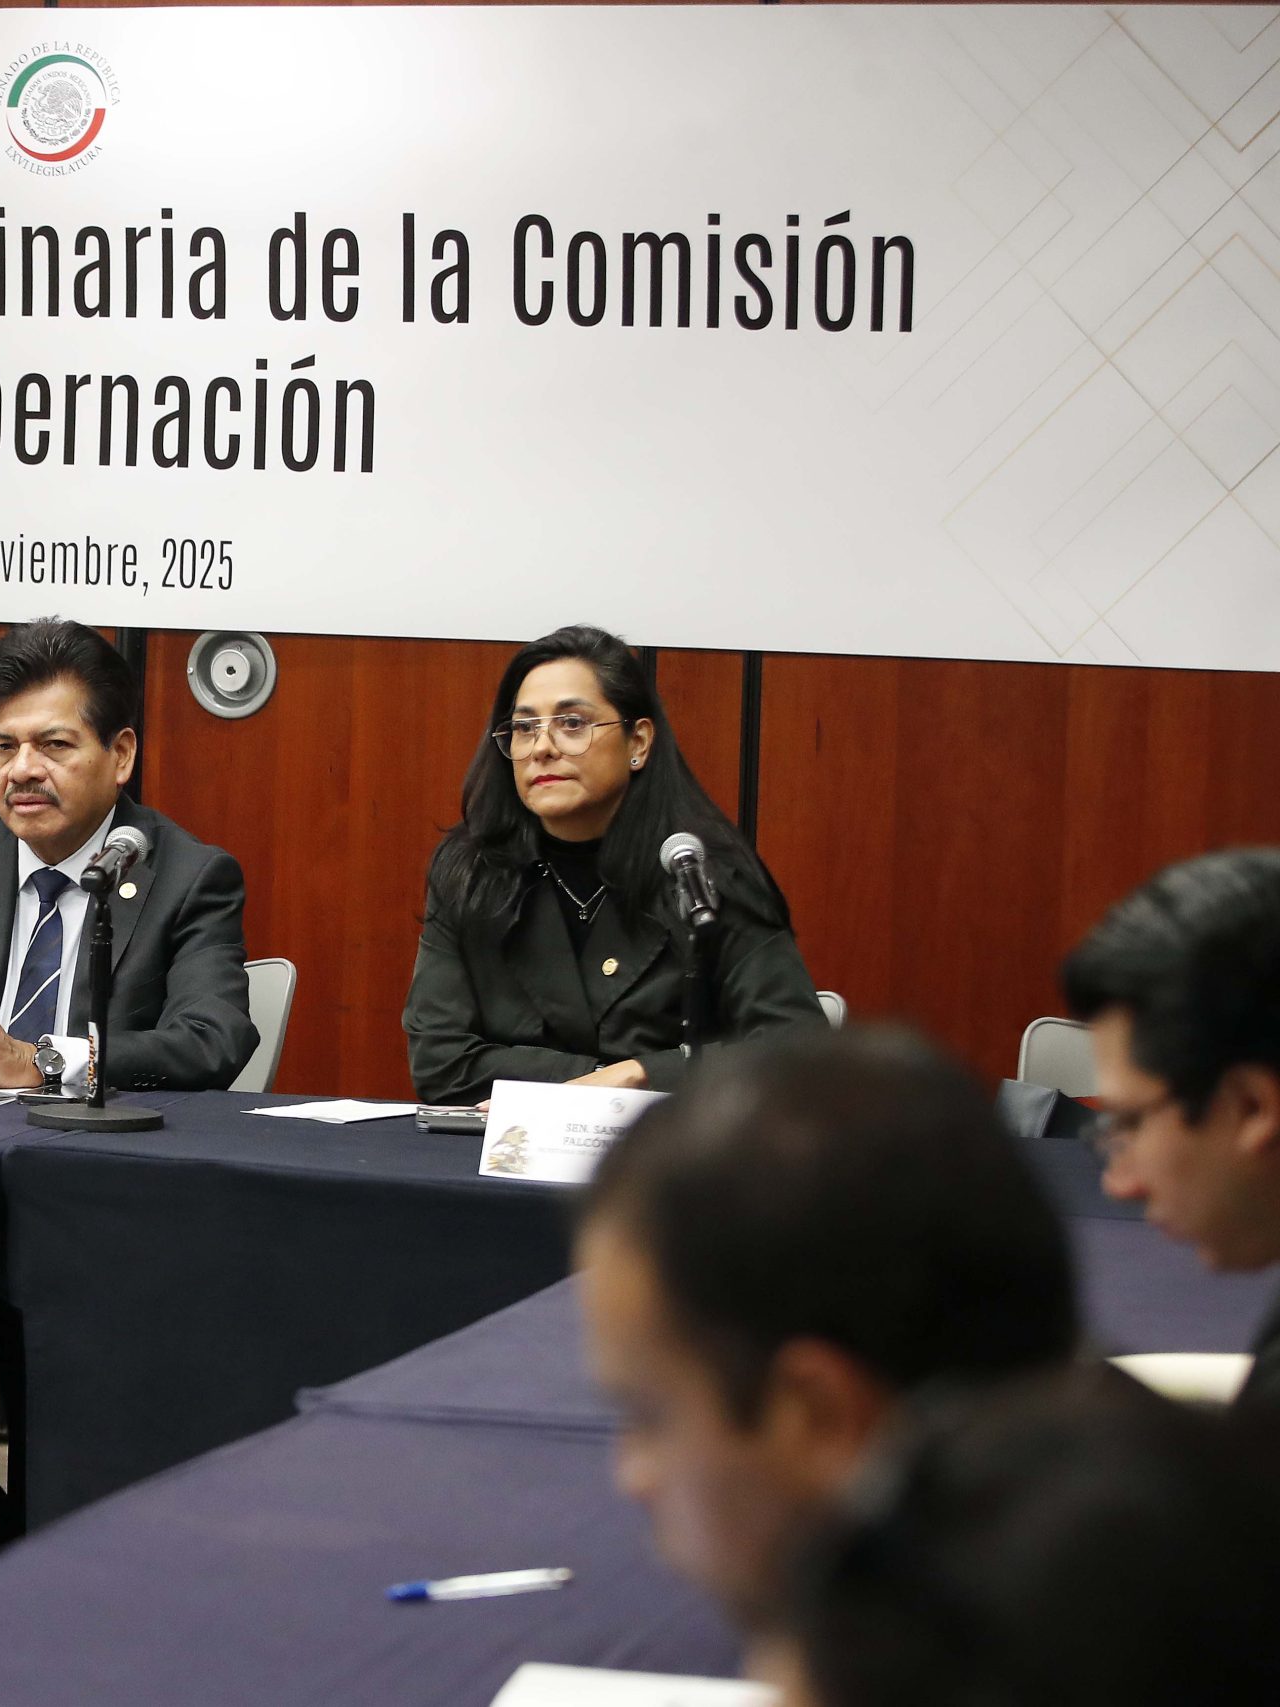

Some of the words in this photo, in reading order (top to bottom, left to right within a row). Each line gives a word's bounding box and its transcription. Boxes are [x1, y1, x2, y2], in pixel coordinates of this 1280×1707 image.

[31, 42, 50, 57] DE
[54, 41, 70, 52] LA
[75, 43, 121, 106] REPÚBLICA
[5, 145, 30, 171] LXVI
[29, 145, 103, 176] LEGISLATURA
[269, 212, 360, 322] de
[403, 213, 470, 323] la
[514, 210, 915, 332] Comisión
[162, 539, 233, 590] 2025
[565, 1123, 589, 1133] SEN.
